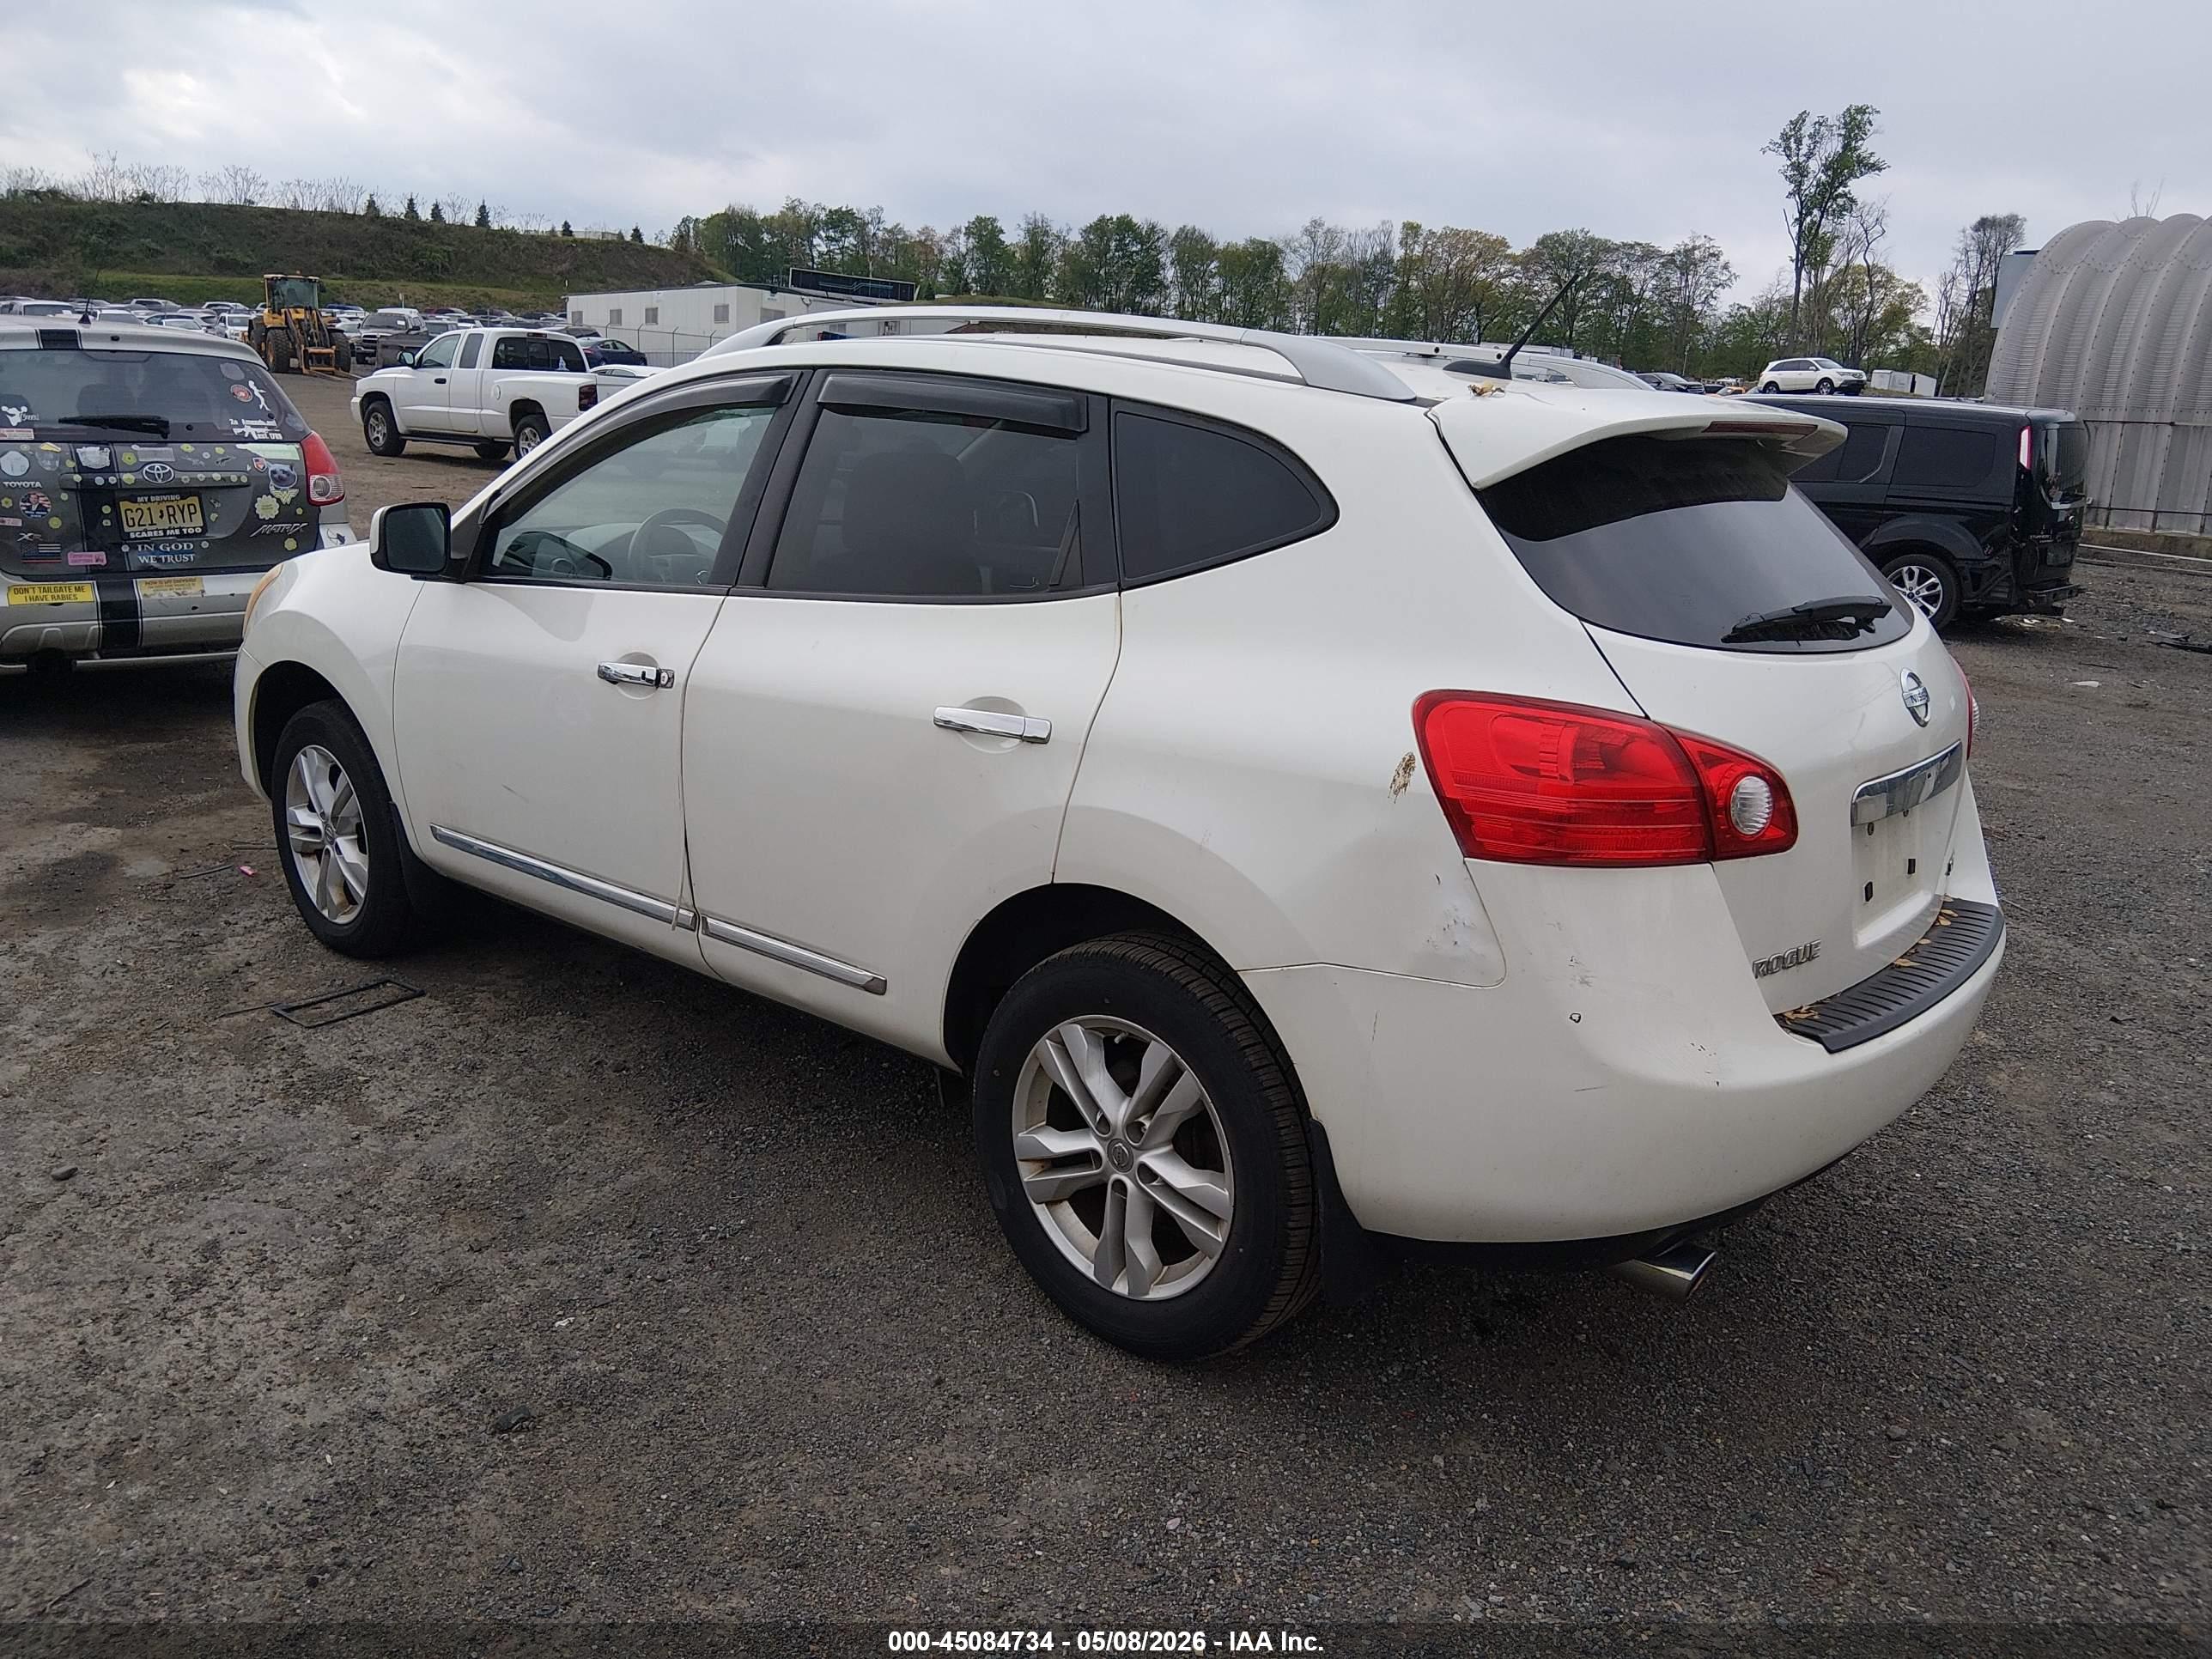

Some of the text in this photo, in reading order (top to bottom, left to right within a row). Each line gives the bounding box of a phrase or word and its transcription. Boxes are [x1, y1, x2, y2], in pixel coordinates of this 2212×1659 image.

[125, 503, 198, 528] G21 RYP
[130, 529, 164, 538] SCARES
[159, 542, 194, 552] GOD
[138, 553, 196, 563] WE TRUST
[14, 586, 36, 595] DON'T
[37, 586, 73, 594] TAILGATE
[1752, 939, 1821, 979] ROGUE
